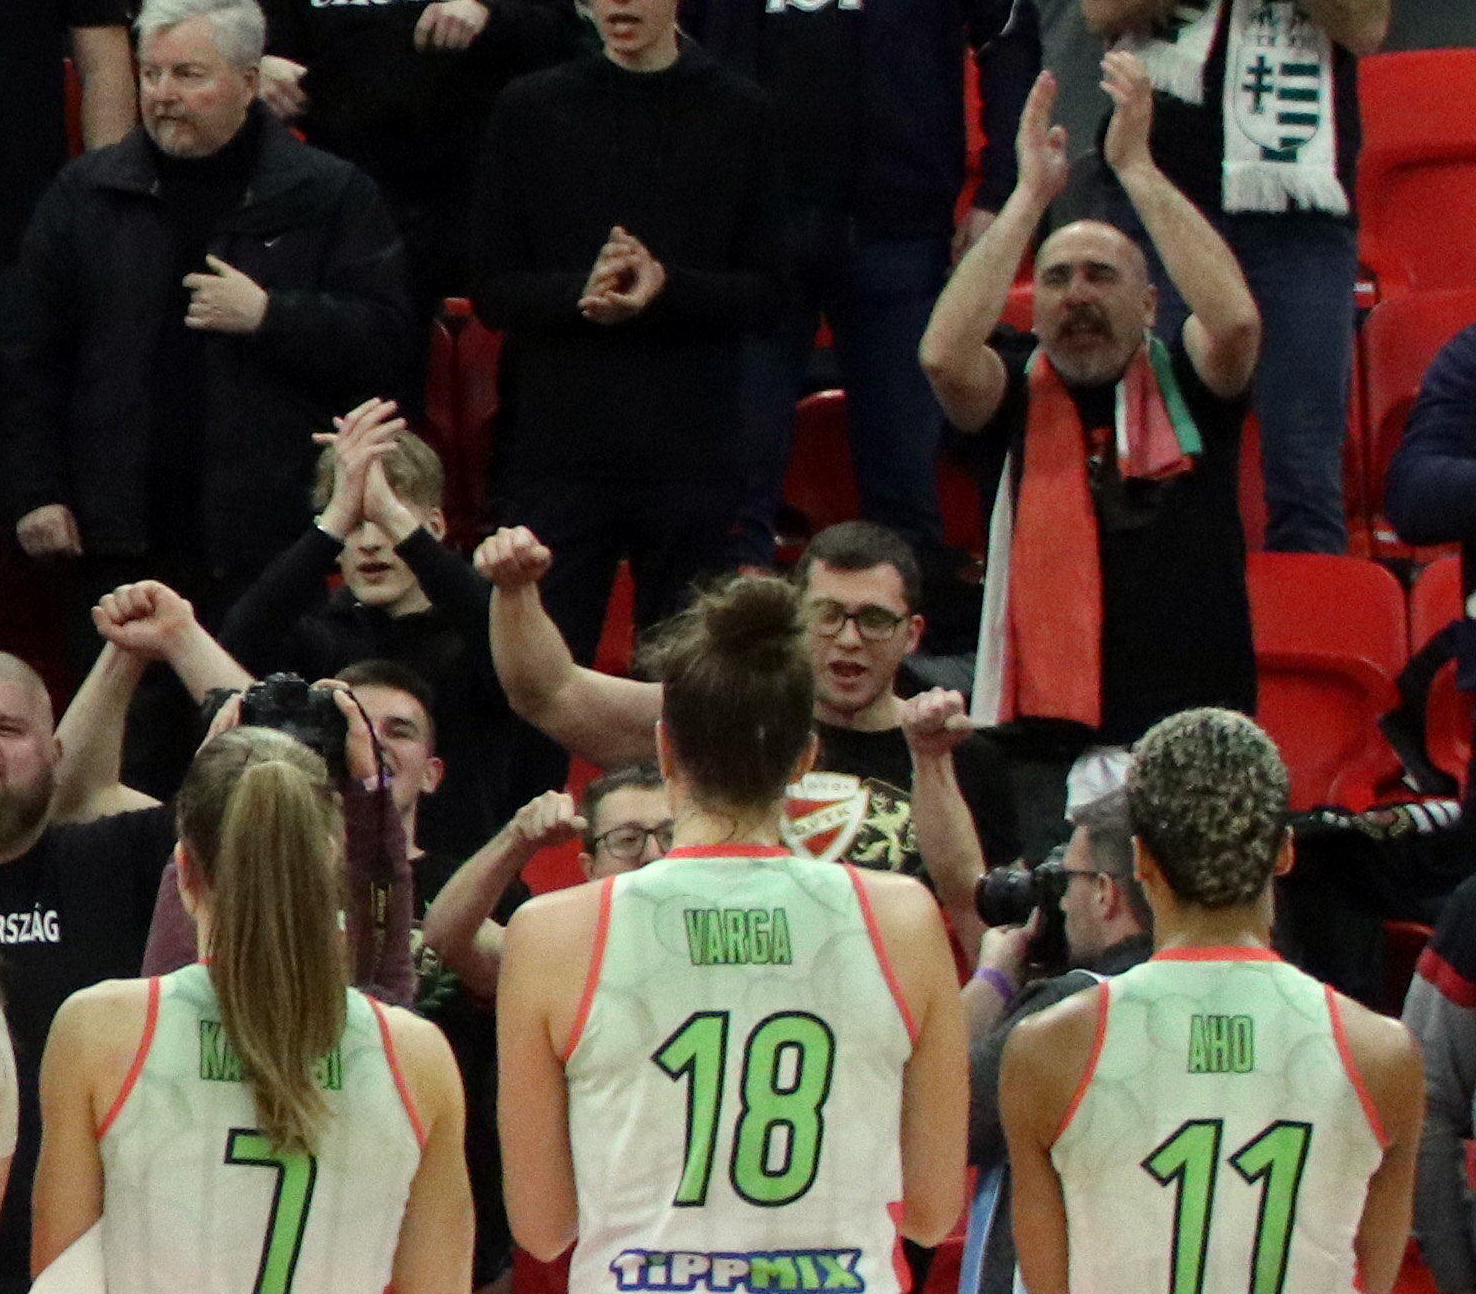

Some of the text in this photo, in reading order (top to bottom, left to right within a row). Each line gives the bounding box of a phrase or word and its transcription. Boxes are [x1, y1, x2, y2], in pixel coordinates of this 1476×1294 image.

[683, 907, 793, 966] VARGA
[1188, 1013, 1255, 1074] AHO
[653, 1010, 837, 1208] 18
